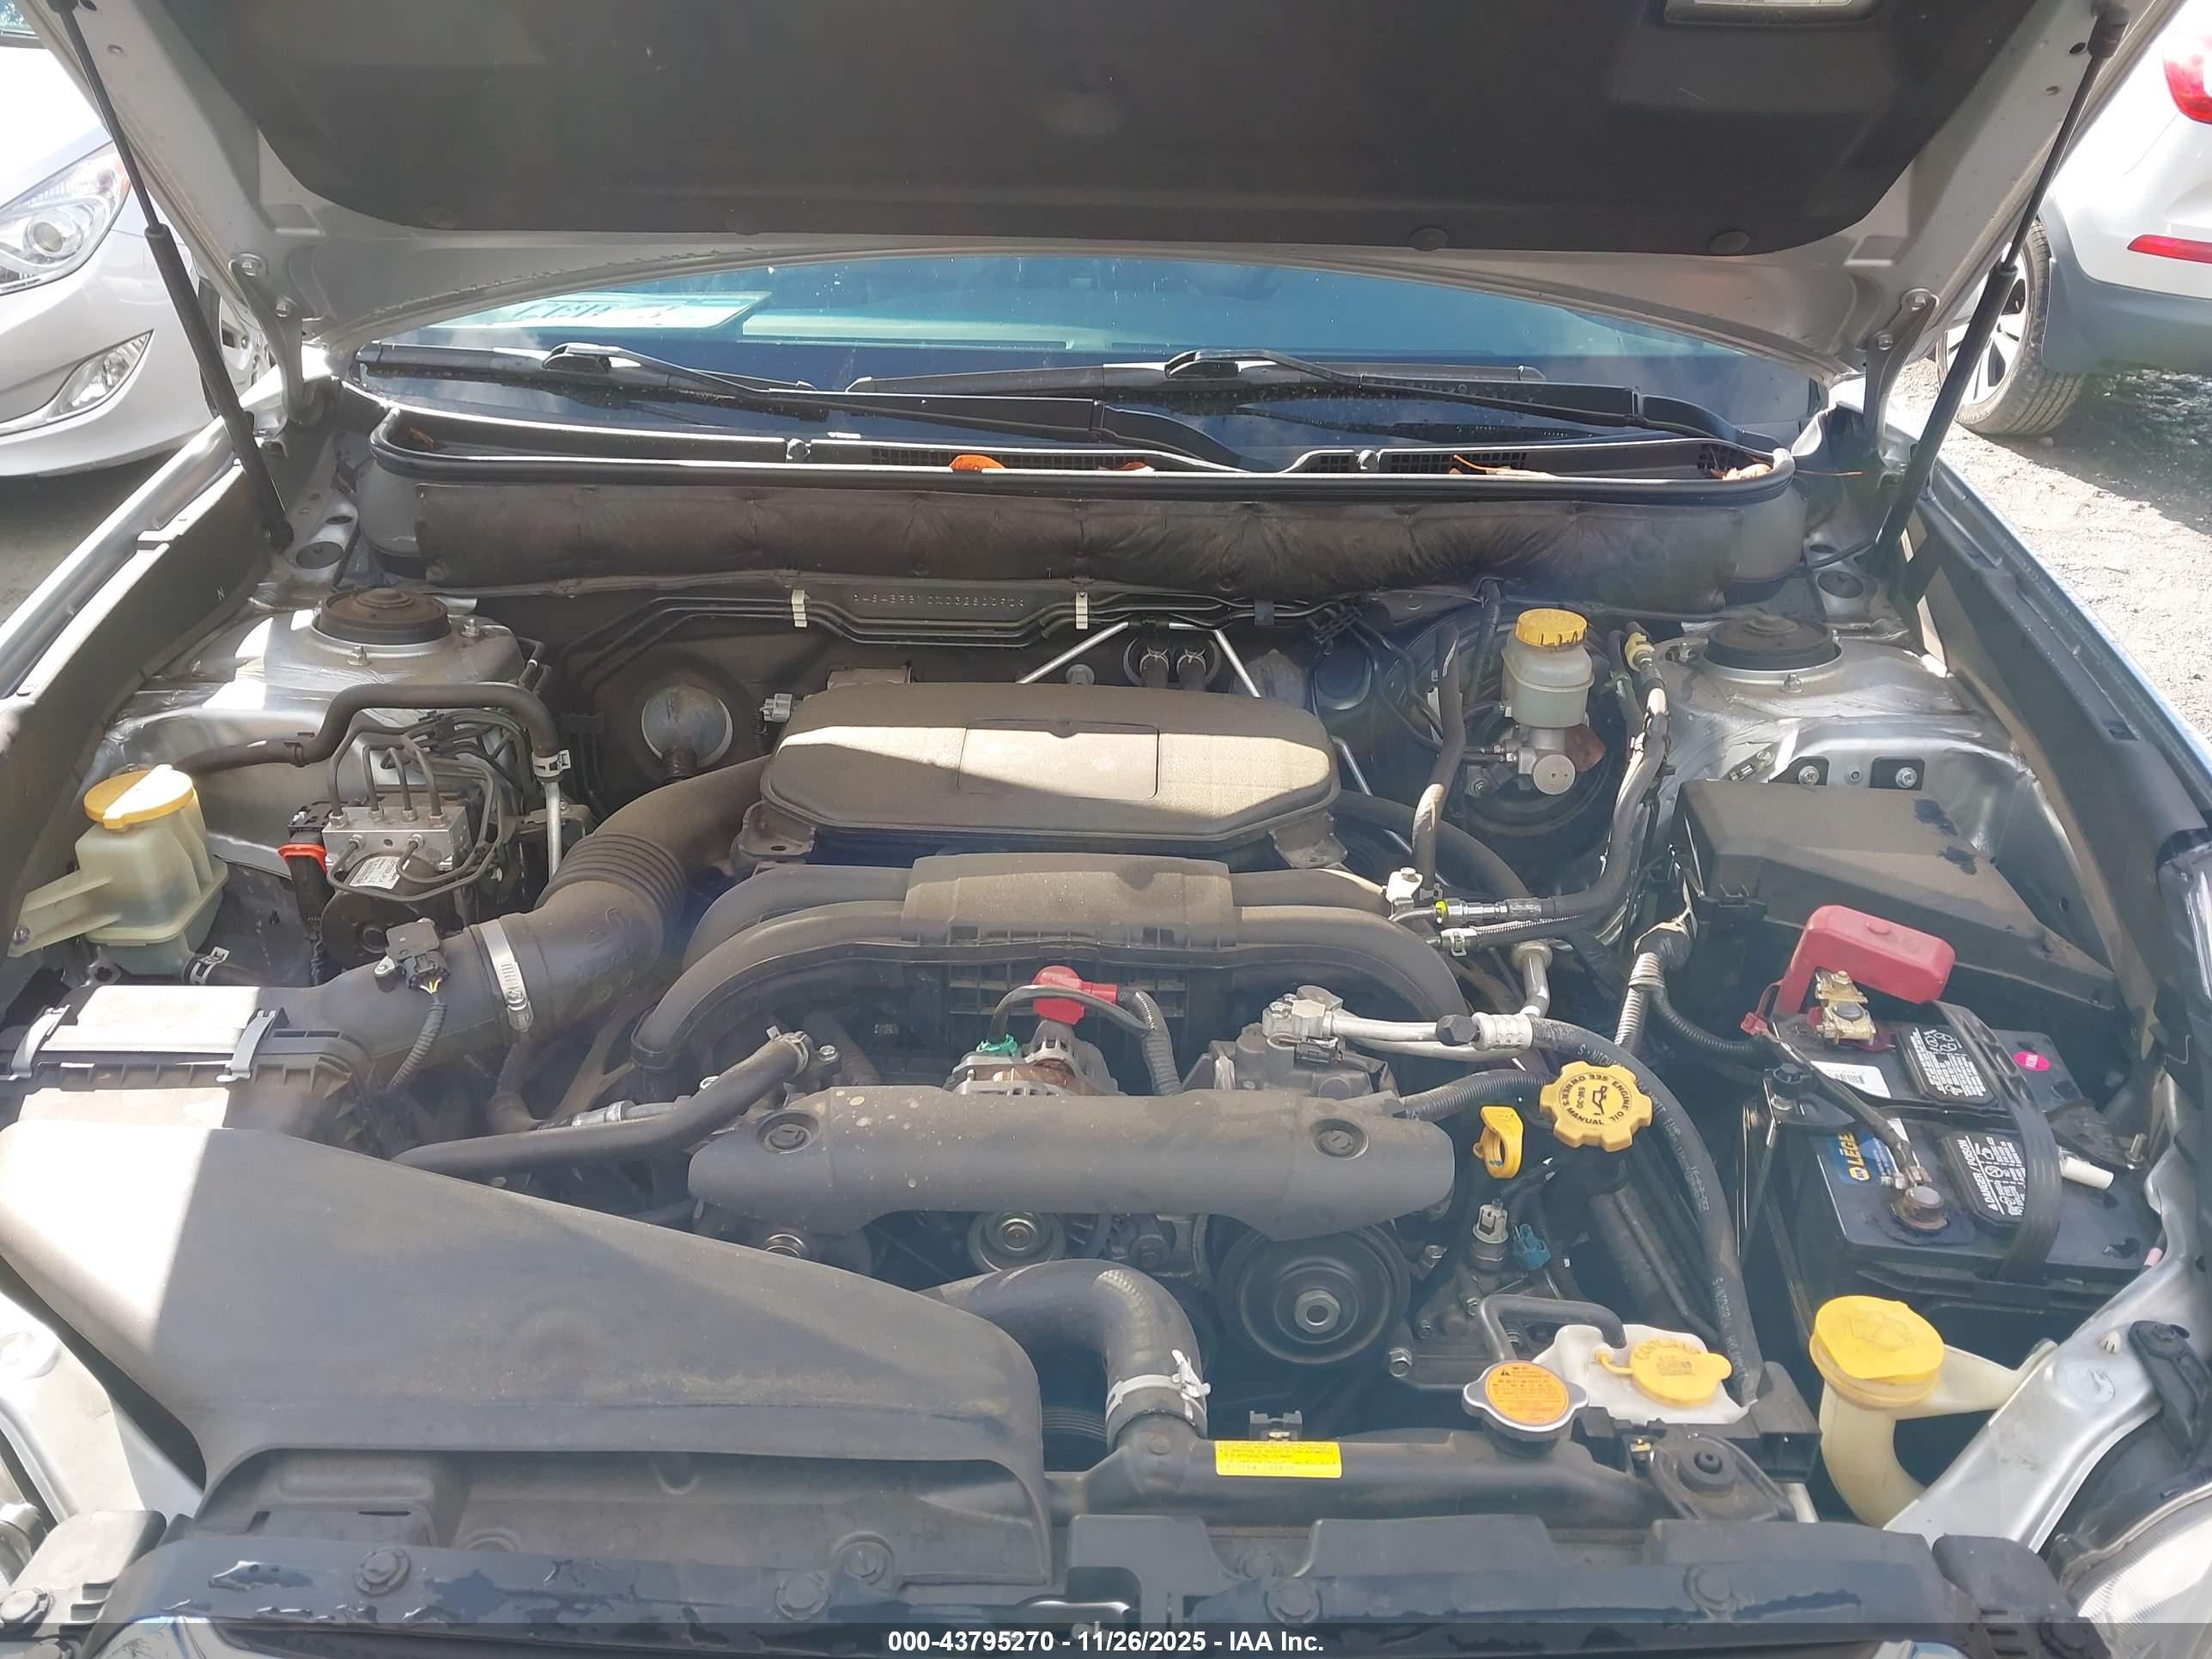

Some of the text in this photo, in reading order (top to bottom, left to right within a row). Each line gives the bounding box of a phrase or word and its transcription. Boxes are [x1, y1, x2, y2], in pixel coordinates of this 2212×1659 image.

[1608, 1080, 1630, 1121] ENGINE OIL
[1565, 1107, 1605, 1126] MANUAL
